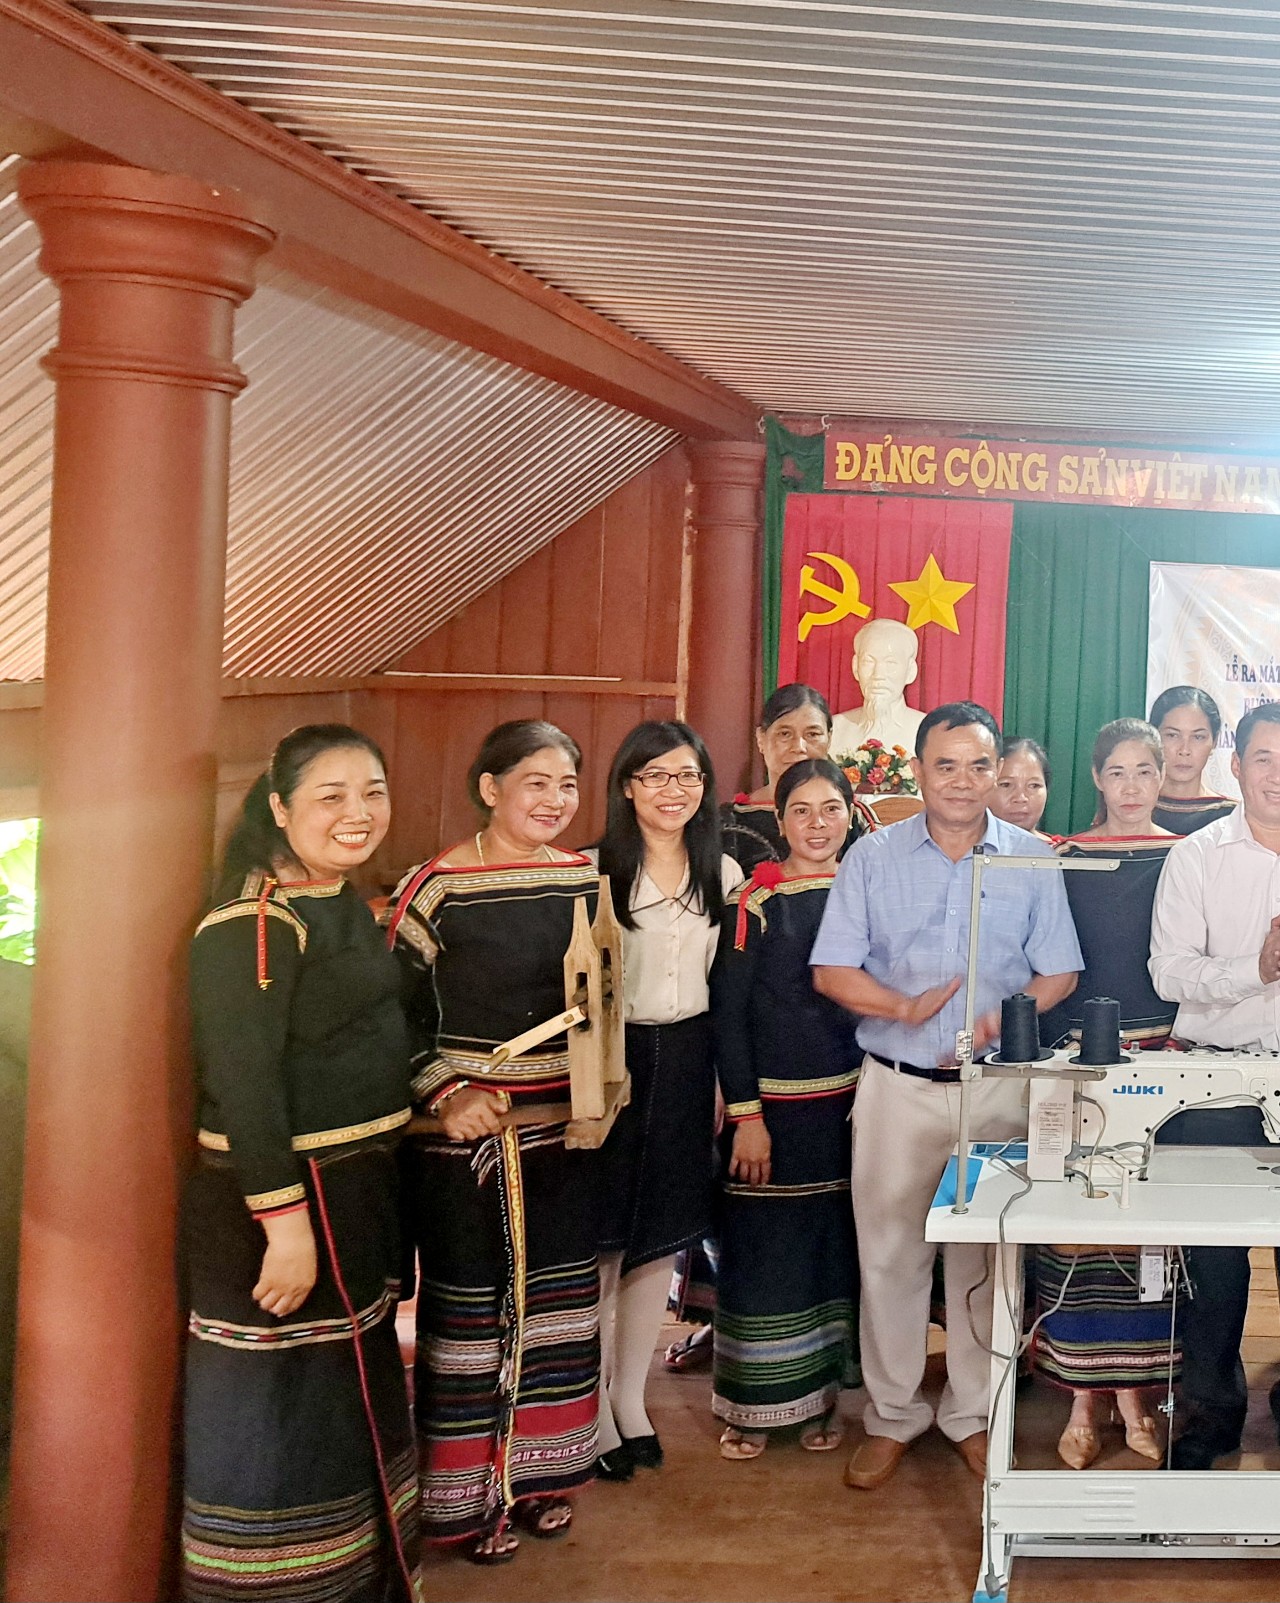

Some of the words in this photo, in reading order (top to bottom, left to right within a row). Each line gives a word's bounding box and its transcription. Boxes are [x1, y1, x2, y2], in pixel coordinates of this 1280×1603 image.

[835, 434, 937, 486] ĐẢNG
[944, 440, 1049, 495] CỘNG
[1225, 654, 1239, 682] LỄ
[1241, 664, 1257, 683] RA
[1112, 1085, 1164, 1095] JUKI
